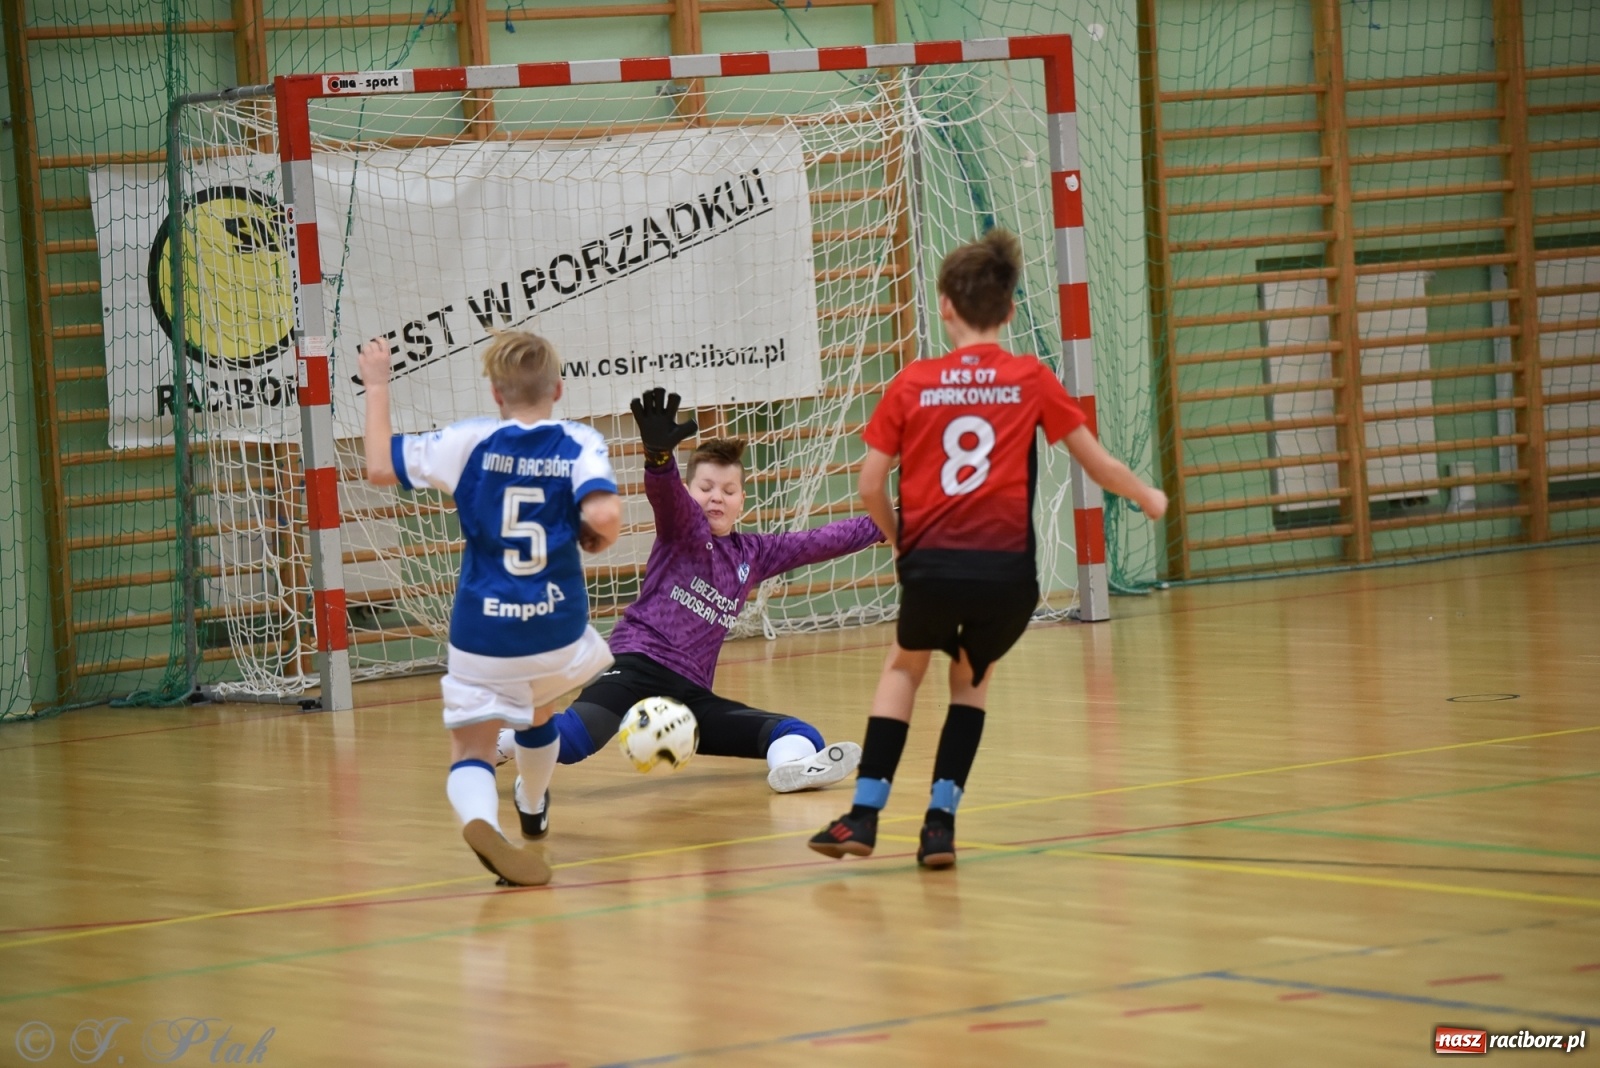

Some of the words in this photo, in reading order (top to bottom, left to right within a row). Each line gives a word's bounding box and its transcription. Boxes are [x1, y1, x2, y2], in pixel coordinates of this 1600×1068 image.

[366, 75, 399, 90] sport
[466, 281, 513, 332] W
[520, 167, 770, 311] PORZĄDKU!
[292, 269, 301, 329] sport
[919, 386, 1022, 407] MARKOWICE
[940, 369, 973, 385] LKS
[975, 369, 997, 384] 07
[482, 452, 514, 475] UNIA
[940, 415, 996, 497] 8
[501, 486, 546, 576] 5
